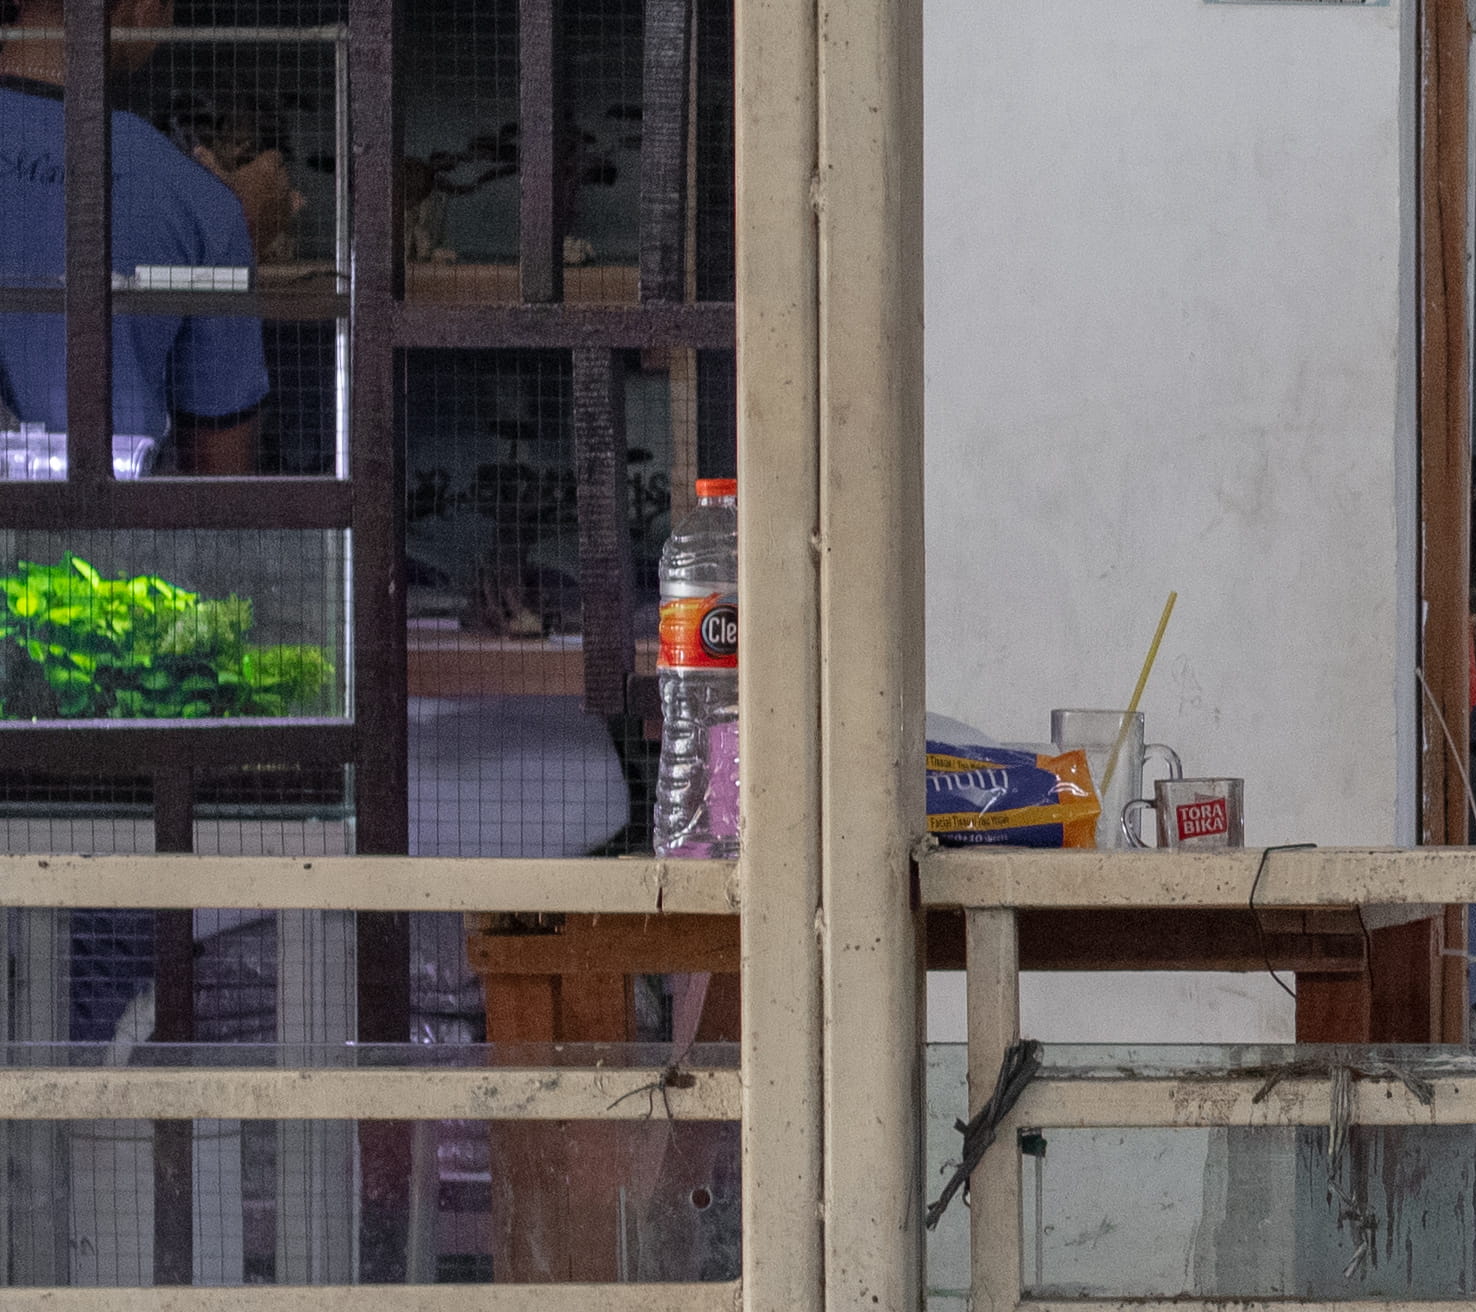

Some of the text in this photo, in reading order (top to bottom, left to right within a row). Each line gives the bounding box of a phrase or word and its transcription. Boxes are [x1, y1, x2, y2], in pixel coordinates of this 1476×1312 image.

[708, 616, 737, 644] Cle
[1179, 803, 1223, 820] TORA
[1183, 817, 1223, 835] BIKA
